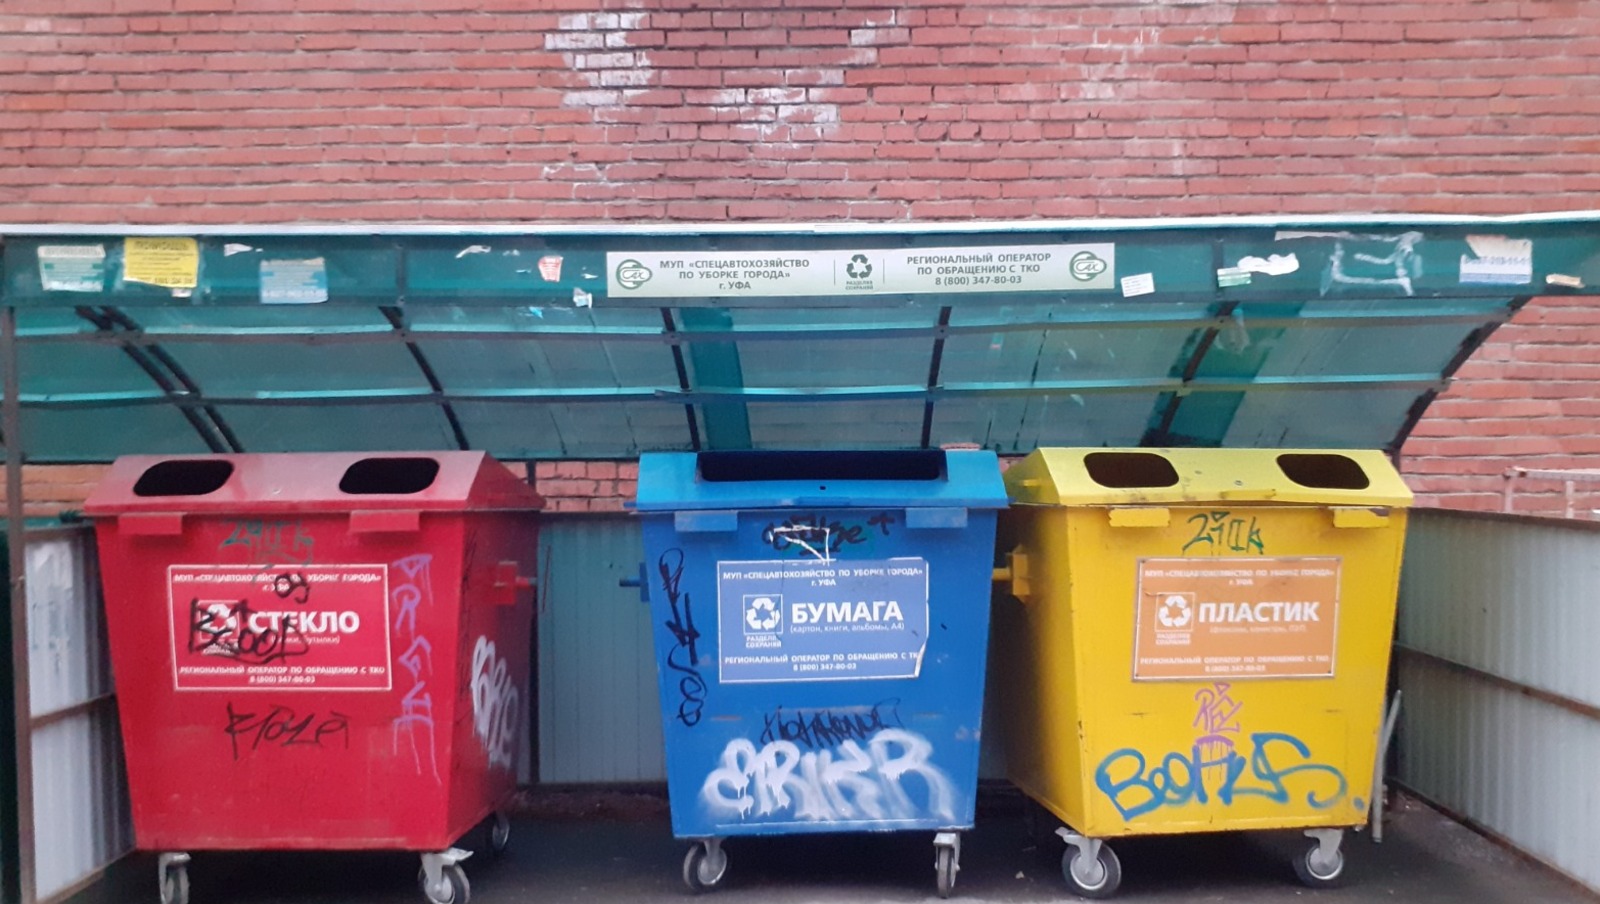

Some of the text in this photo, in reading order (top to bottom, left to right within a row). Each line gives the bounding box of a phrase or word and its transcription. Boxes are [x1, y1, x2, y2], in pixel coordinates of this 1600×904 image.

[660, 258, 809, 269] МУП «СПЕЦАВТОХОЗЯЙСТВО
[907, 253, 1051, 264] РЕГИОНАЛЬНЫЙ ОПЕРАТОР
[679, 270, 790, 280] ПО УБОРКЕ ГОРОДА»
[917, 264, 1040, 275] ПО ОБРАЩЕНИЮ С ТКО
[719, 281, 751, 290] г. УФА
[935, 275, 1022, 286] 8 (800) 347-80-03
[723, 568, 923, 580] МУП «СПЕЦАВТОХОЗЯЙСТВО ПО УБОРКЕ ГОРОДА»
[818, 579, 836, 587] УФА
[792, 600, 904, 624] БУМАГА
[1199, 601, 1320, 623] ПЛАСТИК
[249, 610, 360, 634] СТЕКЛО
[790, 621, 904, 634] (картон, книги, альбомы, А4)
[725, 655, 788, 664] РЕГИОНАЛЬНЫЙ
[791, 654, 831, 663] ОПЕРАТОР
[847, 652, 898, 662] ОБРАЩЕНИЮ
[901, 652, 906, 660] С
[909, 652, 919, 660] ТК
[180, 665, 385, 675] РЕГИОНАЛЬНЫЙ ОПЕРАТОР ПО ОБРАЩЕНИЮ С ТКО
[800, 663, 819, 672] (800)
[820, 663, 857, 671] 347-80-03
